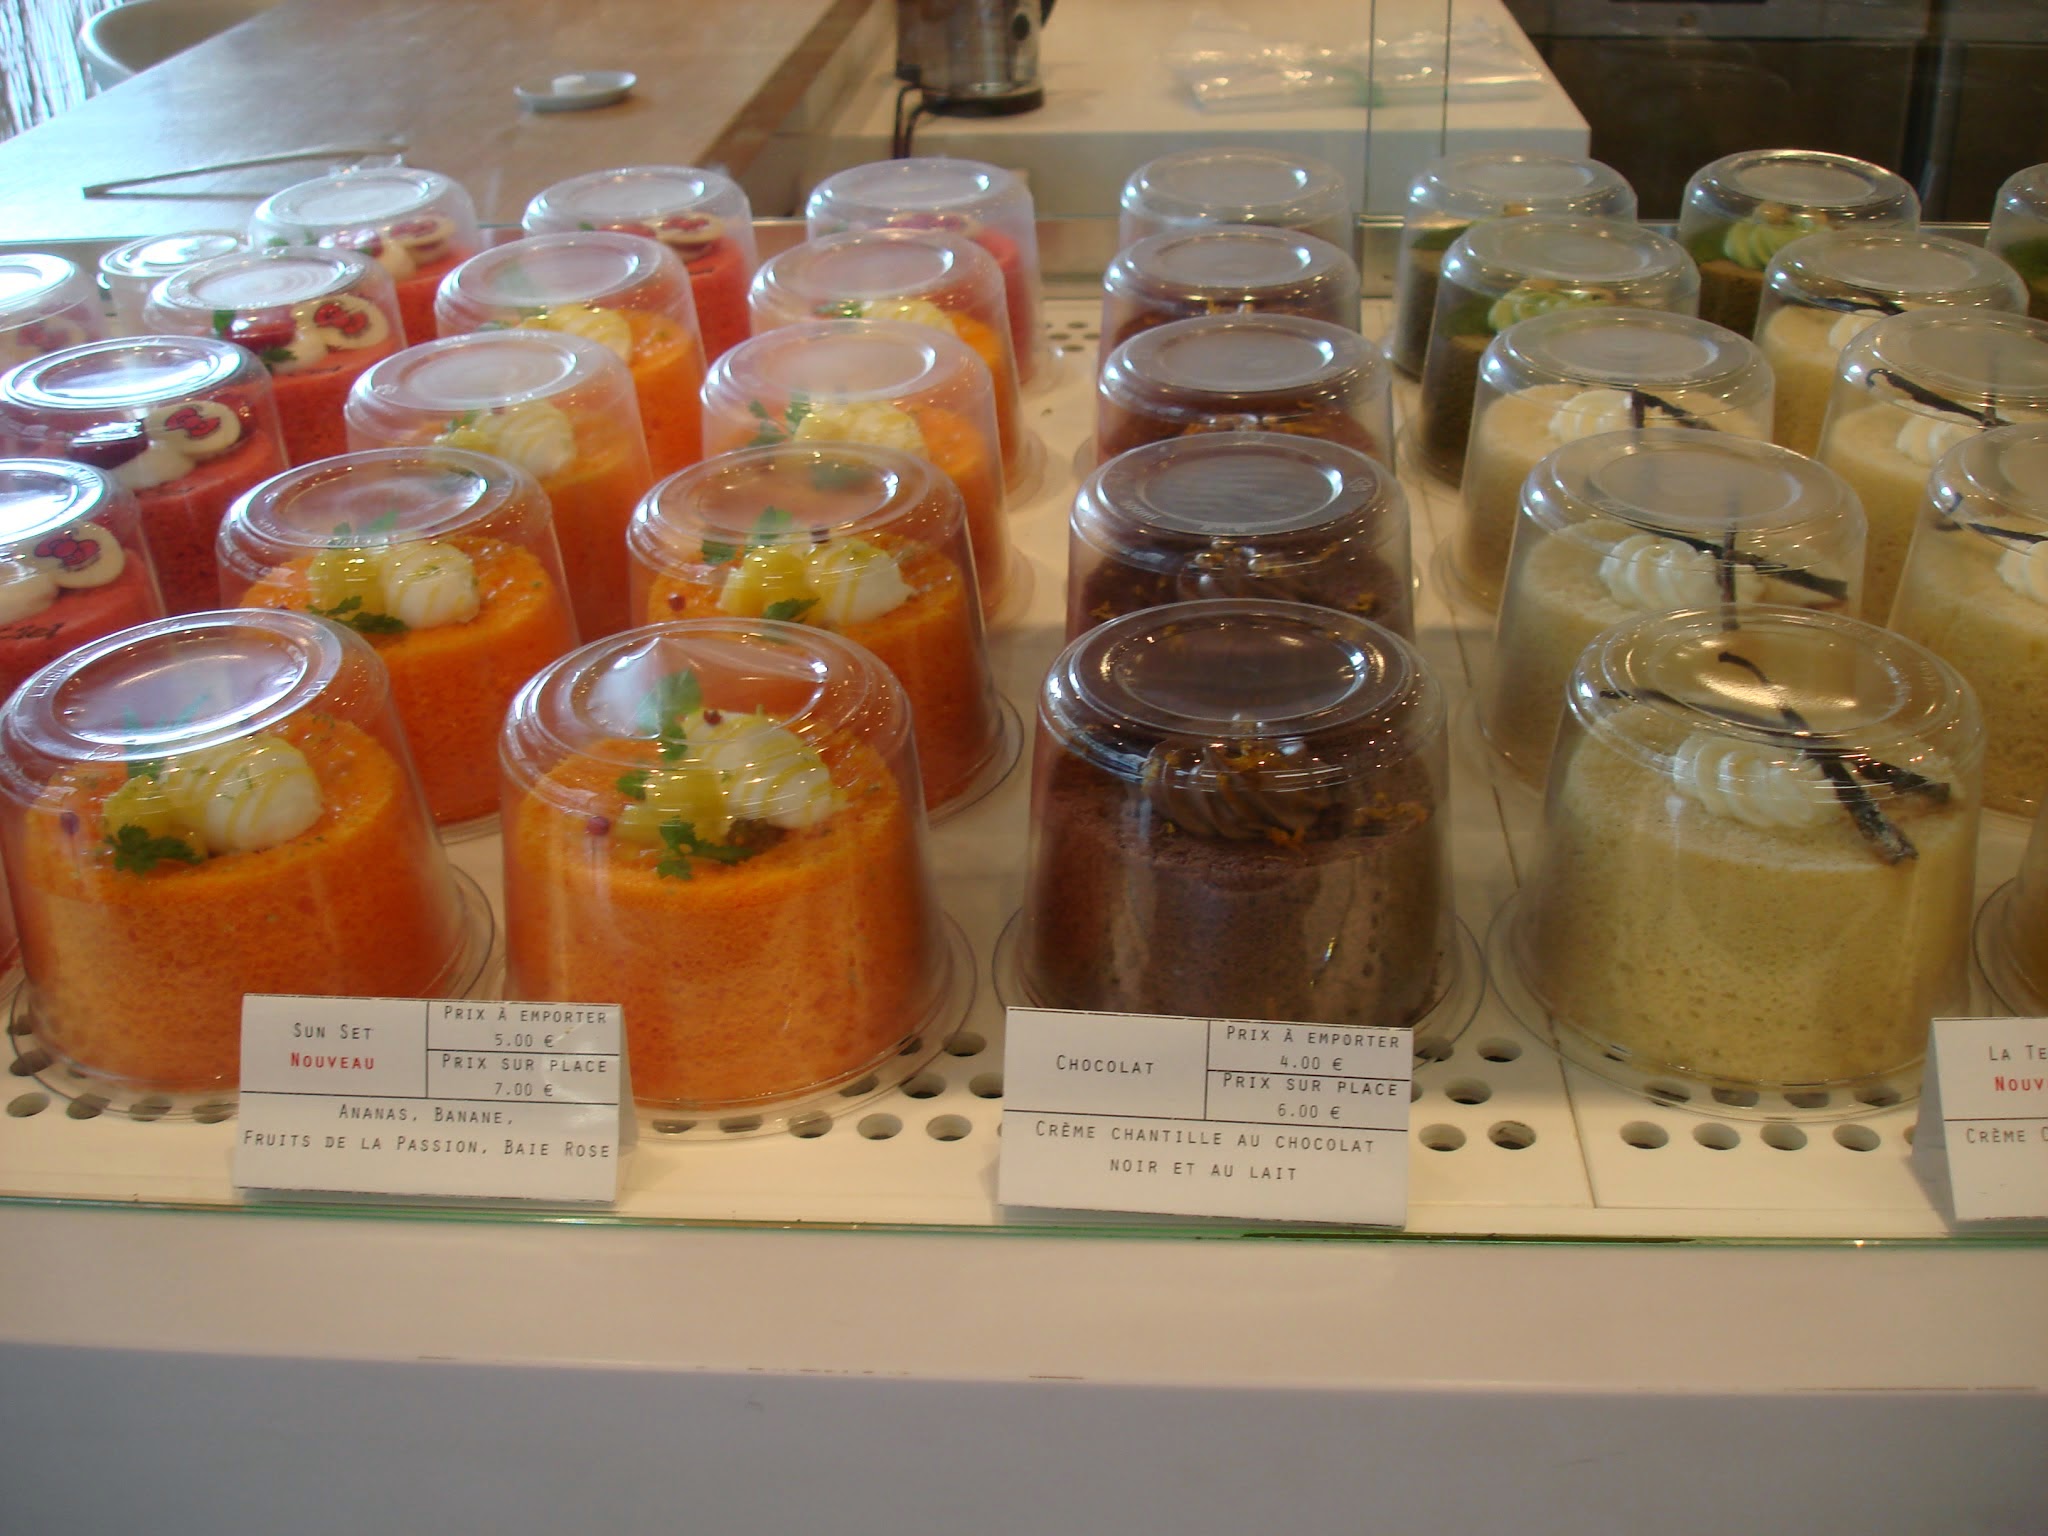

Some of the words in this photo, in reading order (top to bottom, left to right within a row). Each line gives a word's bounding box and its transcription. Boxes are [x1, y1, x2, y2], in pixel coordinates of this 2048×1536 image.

[444, 1005, 486, 1021] PRIX
[497, 1007, 507, 1022] À
[520, 1009, 607, 1025] EMPORTER
[293, 1023, 326, 1039] SUN
[340, 1024, 373, 1041] SET
[494, 1033, 533, 1048] 5.00
[543, 1034, 555, 1048] €
[1226, 1026, 1270, 1042] PRIX
[1283, 1028, 1293, 1043] À
[1307, 1032, 1400, 1049] EMPORTER
[290, 1052, 375, 1070] NOUVEAU
[1988, 1045, 2011, 1061] LA
[441, 1054, 487, 1070] PRIX
[501, 1058, 535, 1071] SUR
[549, 1058, 607, 1074] PLACE
[1056, 1055, 1155, 1075] CHOCOLAT
[1279, 1055, 1321, 1071] 4.00
[1332, 1057, 1343, 1071] €
[494, 1082, 533, 1097] 7.00
[543, 1083, 554, 1097] €
[1222, 1072, 1270, 1090] PRIX
[1286, 1078, 1322, 1093] SUR
[1337, 1081, 1399, 1097] PLACE
[1994, 1075, 2048, 1092] NOUV
[1277, 1103, 1319, 1119] 6.00
[1330, 1106, 1341, 1120] €
[244, 1130, 311, 1147] FRUITS
[325, 1136, 345, 1149] DE
[360, 1136, 382, 1150] LA
[504, 1139, 549, 1157] BAIE
[564, 1142, 610, 1158] ROSE
[1036, 1120, 1096, 1140] CRÈME
[1111, 1126, 1222, 1146] CHANTILLE
[1238, 1133, 1260, 1148] AU
[1275, 1135, 1374, 1154] CHOCOLAT
[1966, 1127, 2025, 1144] CRÈME
[1110, 1158, 1158, 1175] NOIR
[1173, 1161, 1195, 1176] ET
[1210, 1163, 1234, 1177] AU
[1249, 1165, 1298, 1182] LAIT
